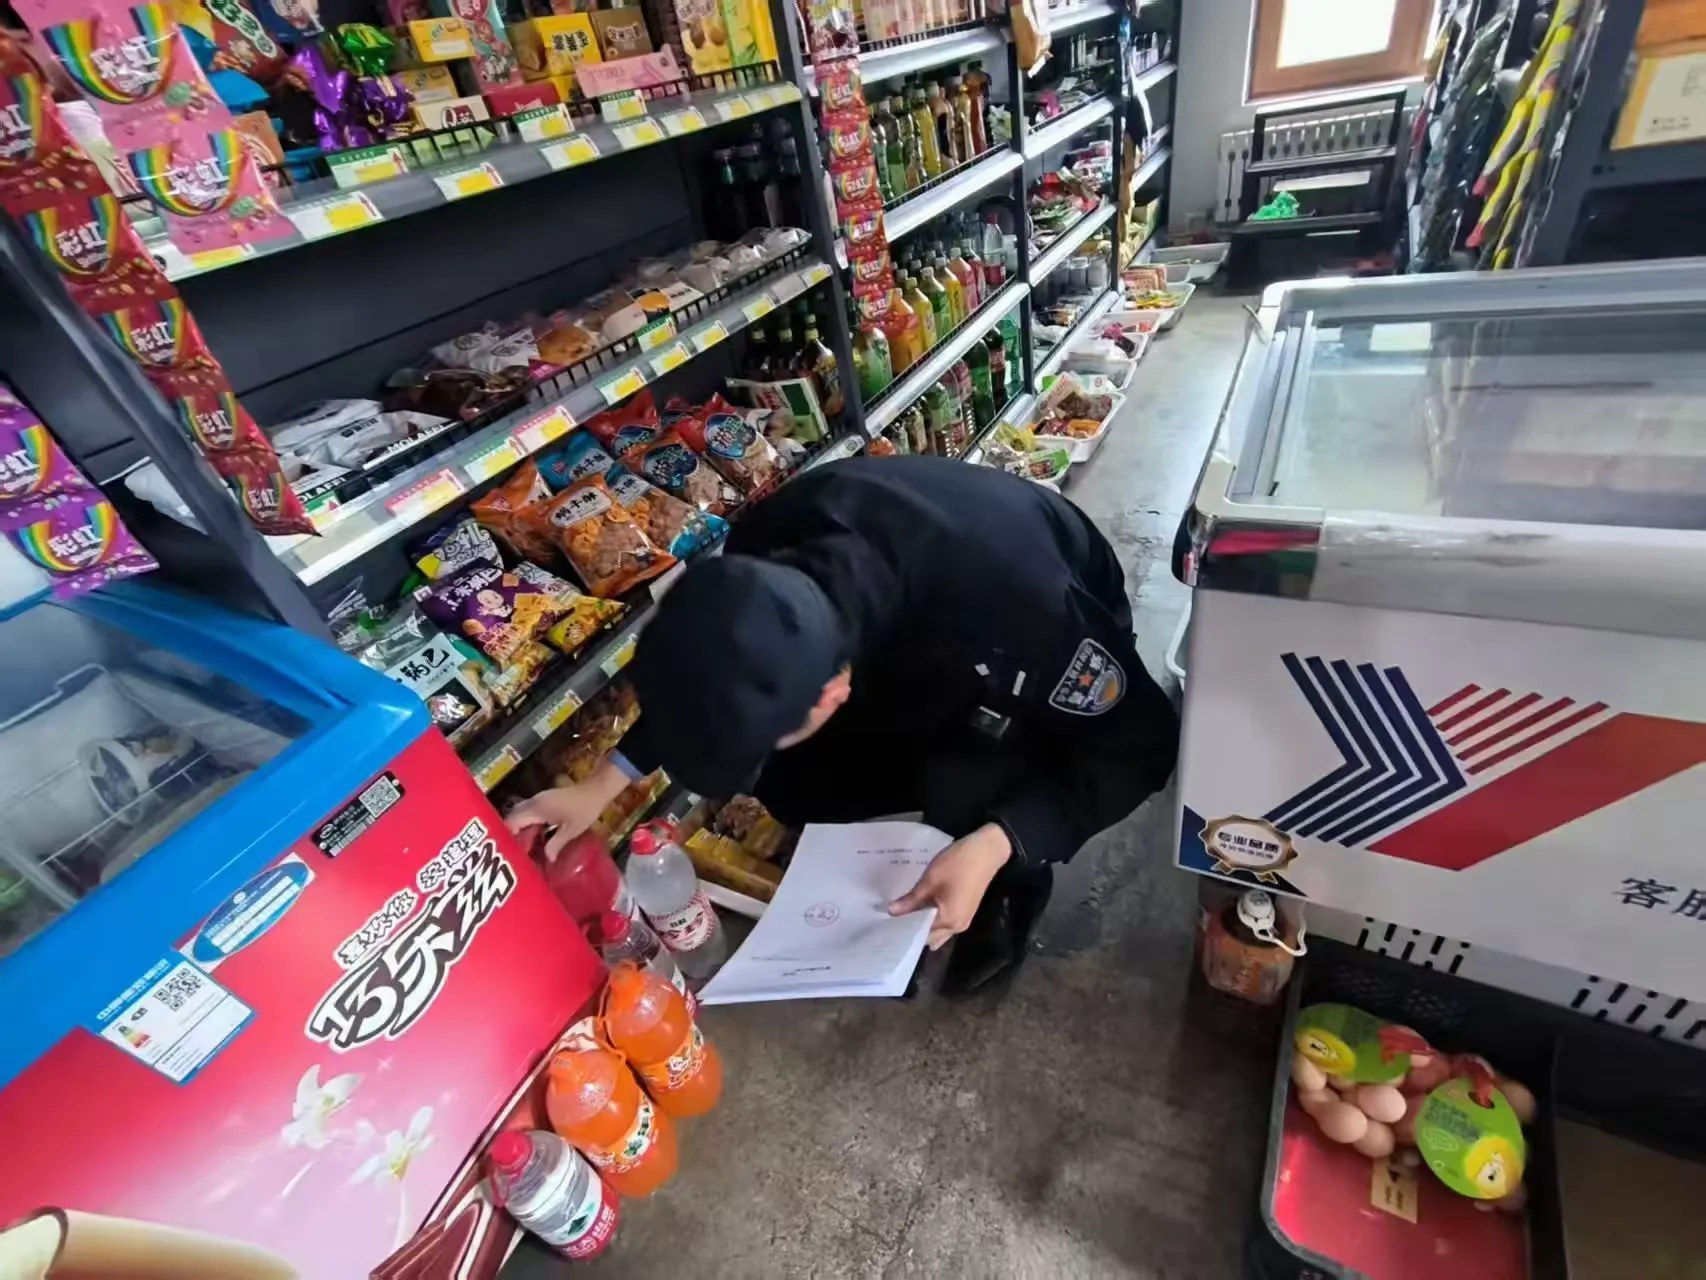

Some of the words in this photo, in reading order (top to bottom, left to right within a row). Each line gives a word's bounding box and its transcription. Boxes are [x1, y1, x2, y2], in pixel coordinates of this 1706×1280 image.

[338, 890, 415, 964] 喜欢你
[420, 820, 487, 889] 没道理
